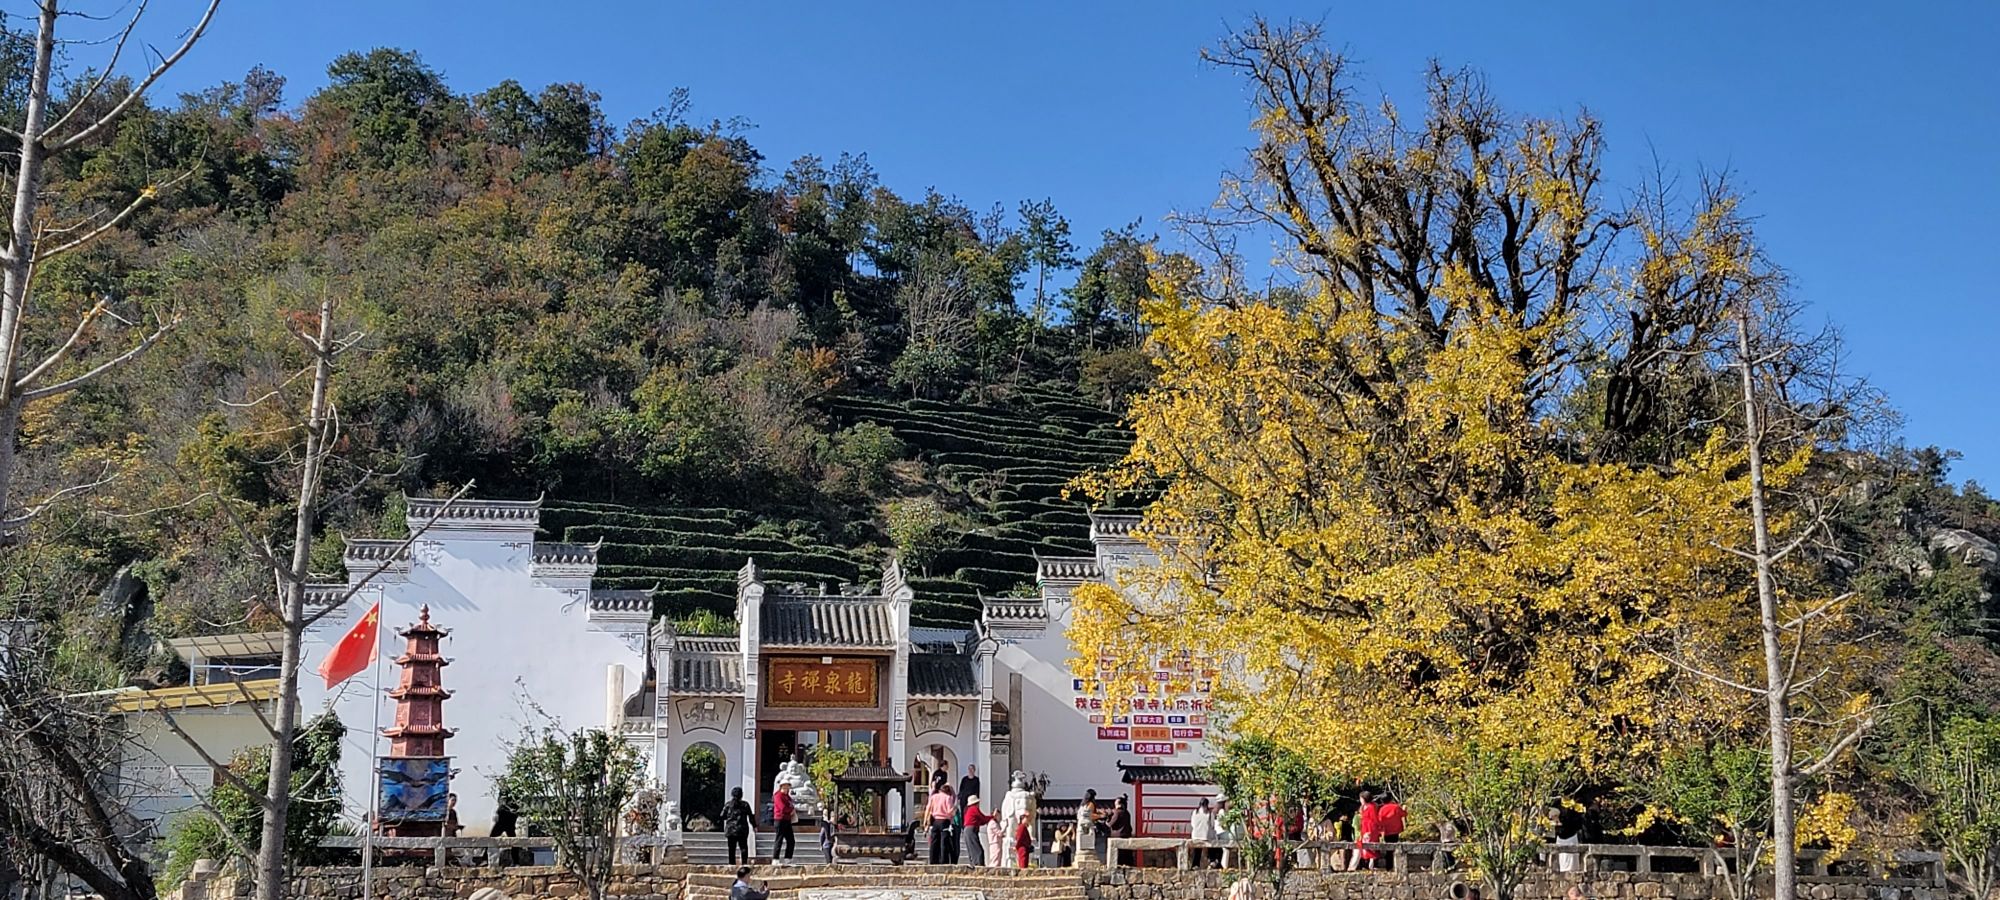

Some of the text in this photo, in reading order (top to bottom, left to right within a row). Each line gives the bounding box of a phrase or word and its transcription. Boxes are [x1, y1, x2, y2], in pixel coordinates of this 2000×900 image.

[778, 670, 866, 694] 龍泉禪寺
[1173, 729, 1201, 737] 知行合一
[1136, 743, 1172, 753] 心想事成
